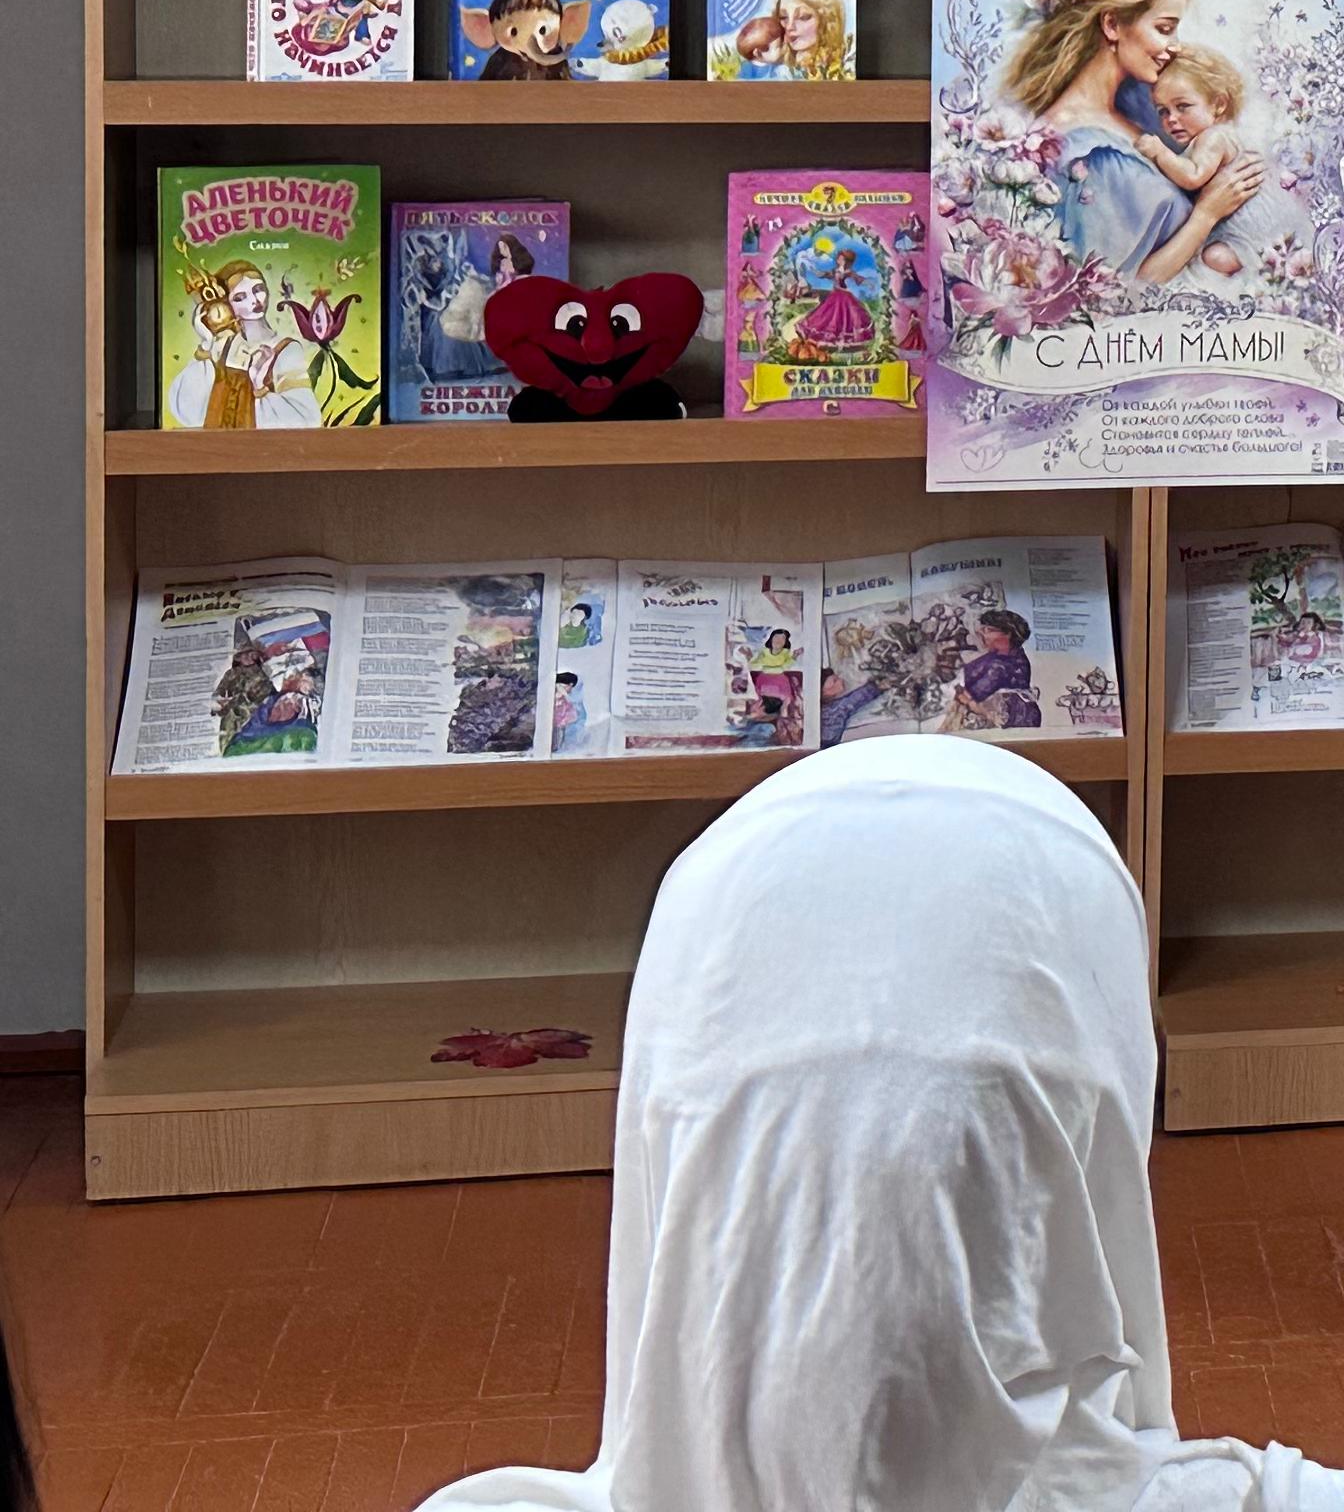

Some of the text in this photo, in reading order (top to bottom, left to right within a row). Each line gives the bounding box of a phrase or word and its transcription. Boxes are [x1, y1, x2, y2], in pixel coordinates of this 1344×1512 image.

[187, 180, 354, 218] АЛЕНЬКИЙ
[185, 206, 352, 245] ЦВЕТОЧЕК
[1036, 328, 1285, 369] С ДНЁМ МАМЫ!
[420, 385, 518, 400] СНЕЖНА
[420, 401, 508, 416] КОРОЛЕ
